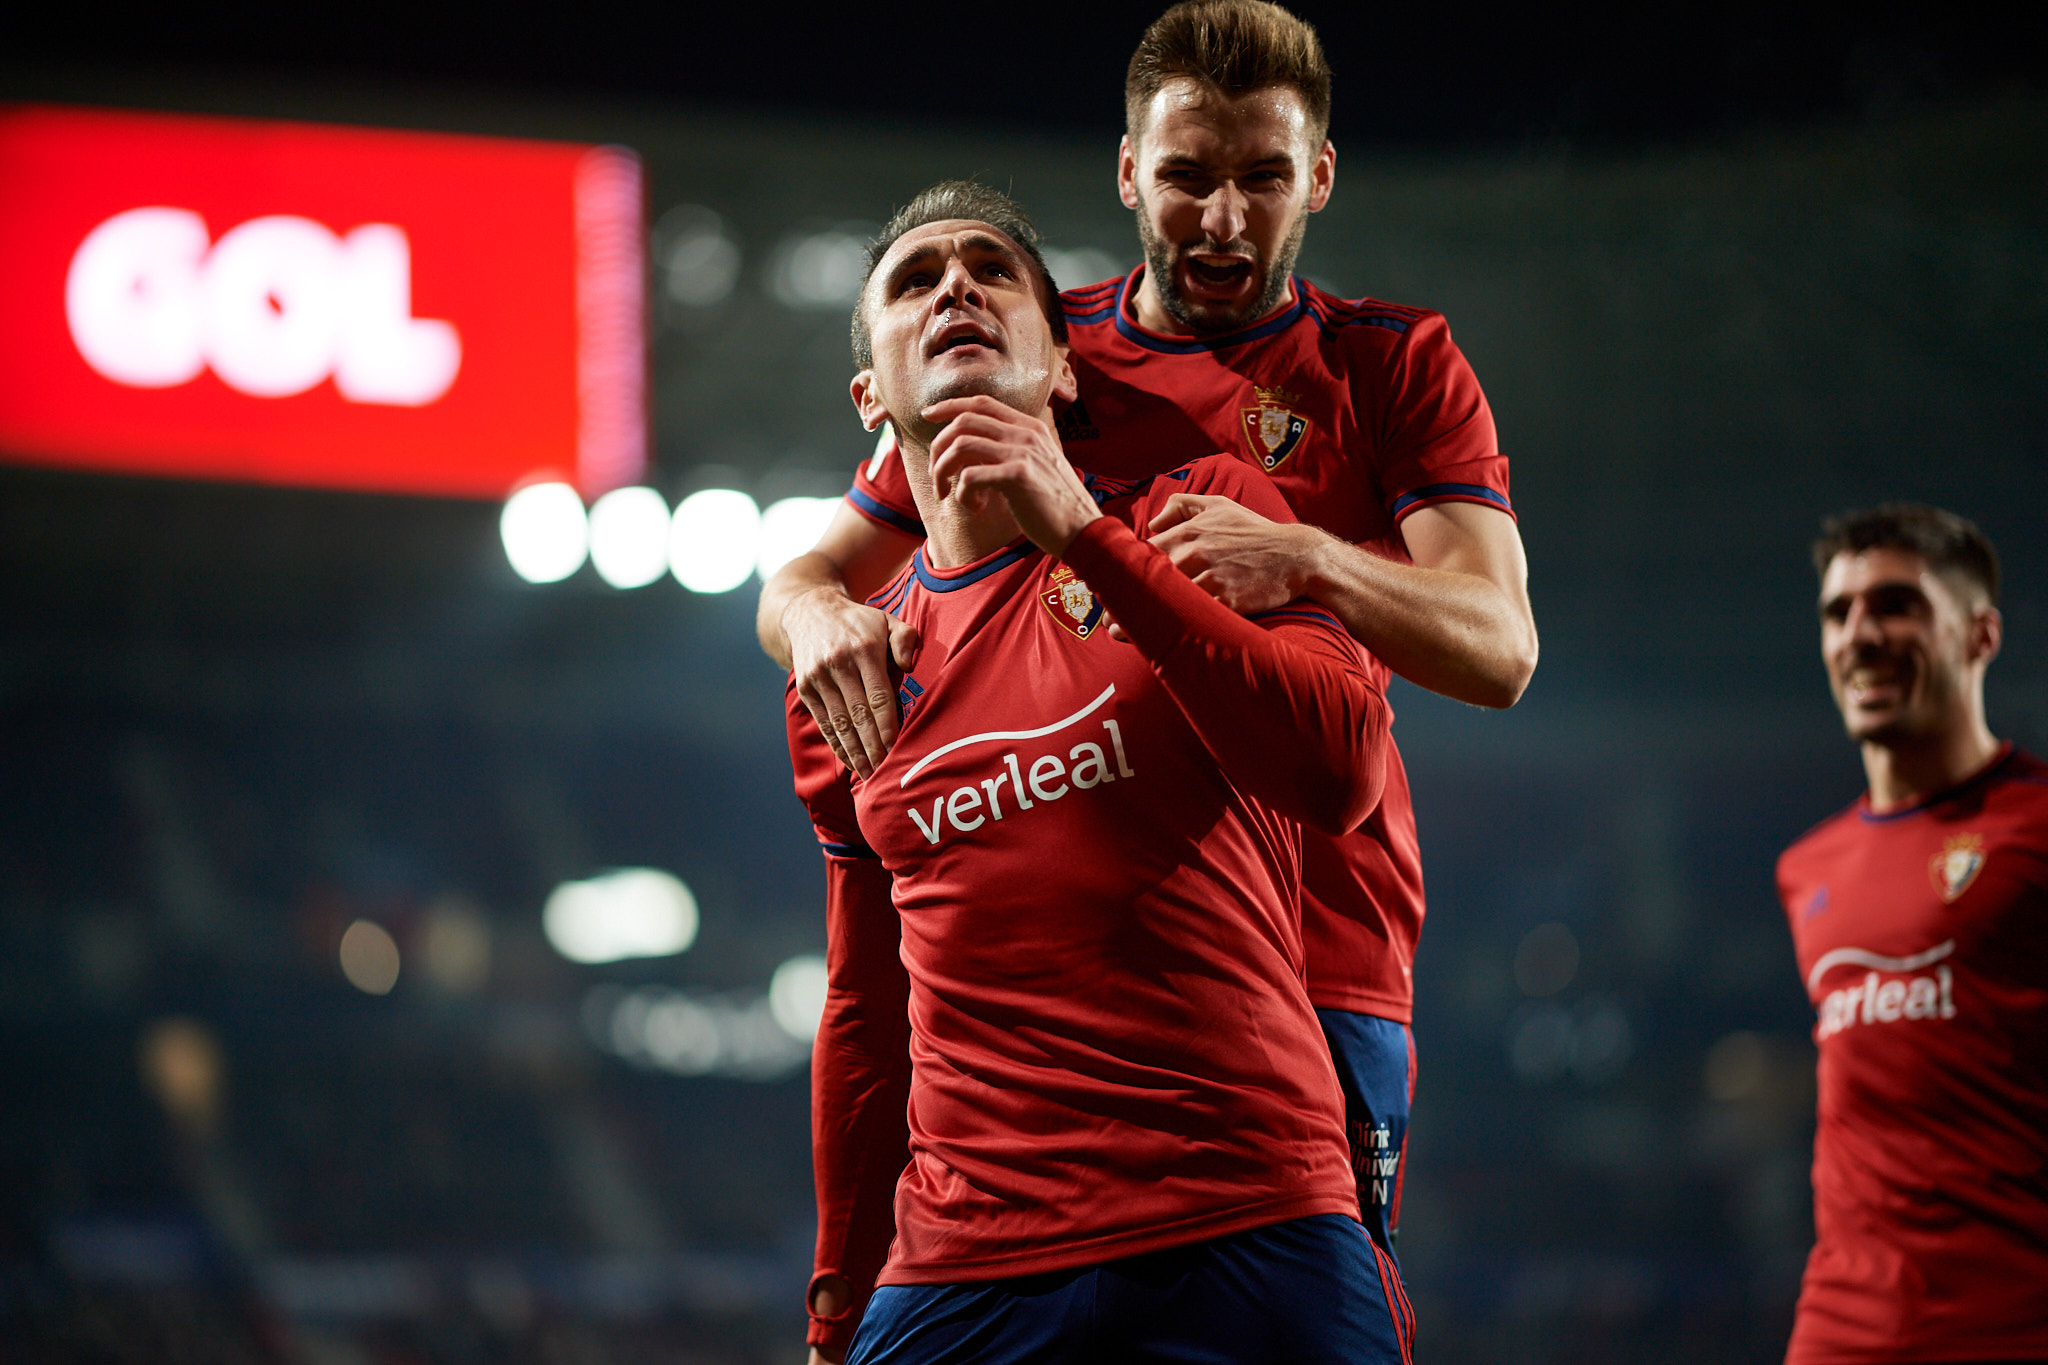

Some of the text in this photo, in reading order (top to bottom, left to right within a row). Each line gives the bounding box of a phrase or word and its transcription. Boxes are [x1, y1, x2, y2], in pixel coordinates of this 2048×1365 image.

[65, 205, 463, 408] GOL
[1246, 414, 1302, 434] C A
[1263, 455, 1275, 467] O
[1047, 594, 1059, 605] C
[1077, 625, 1089, 635] O
[907, 718, 1135, 845] verleal
[1817, 965, 1957, 1041] erleal
